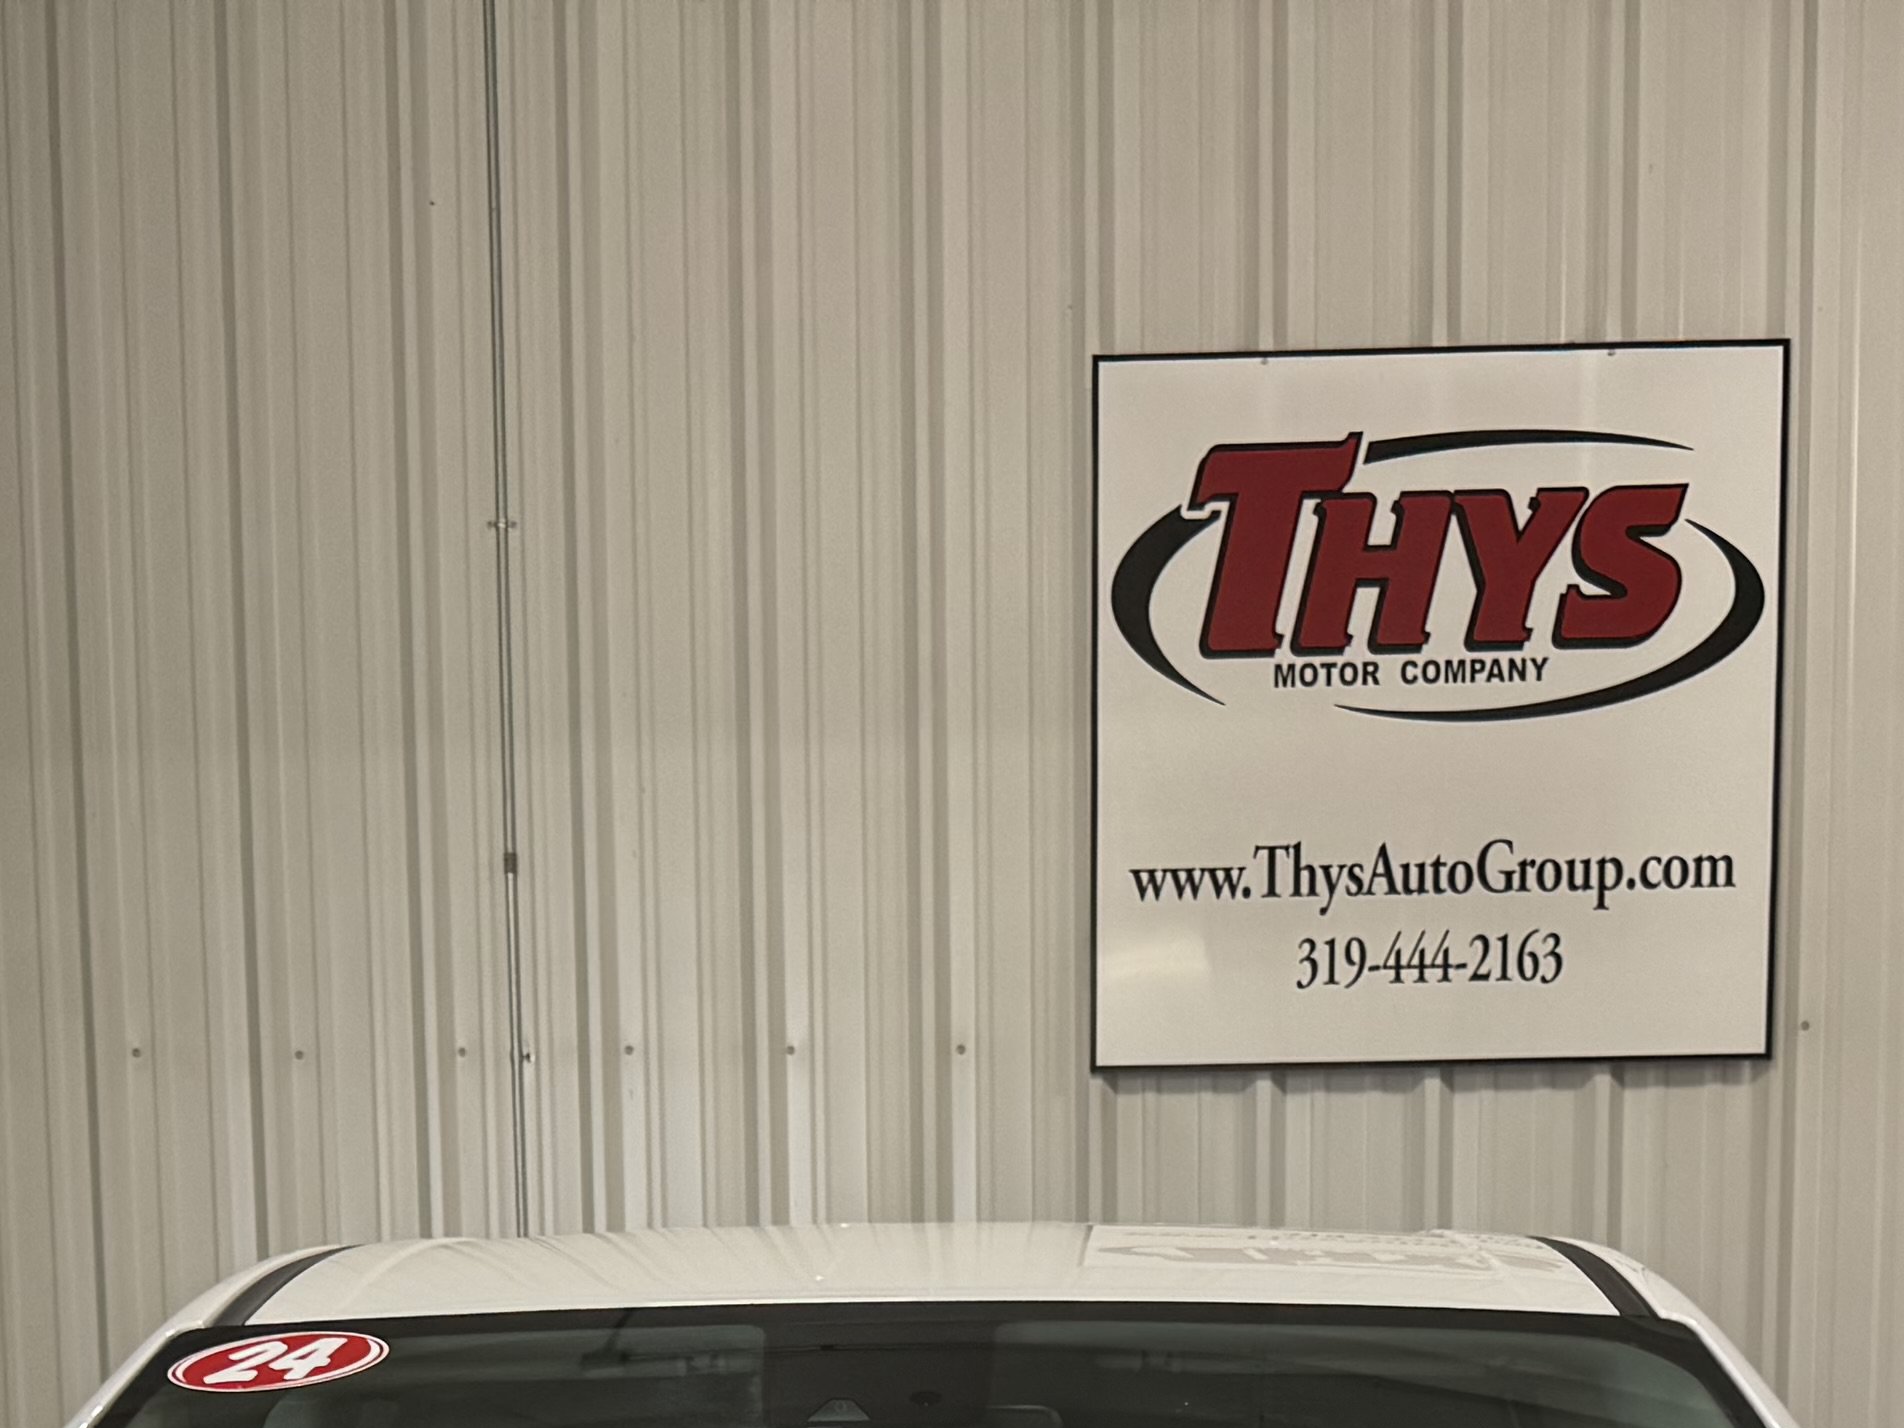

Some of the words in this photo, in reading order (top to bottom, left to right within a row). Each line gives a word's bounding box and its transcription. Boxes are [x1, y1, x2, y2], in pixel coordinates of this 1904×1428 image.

[1187, 431, 1689, 659] THYS
[1273, 660, 1381, 689] MOTOR
[1400, 657, 1550, 684] COMPANY
[1128, 838, 1737, 916] www.ThysAutoGroup.com
[1295, 928, 1563, 990] 319-444-2163
[202, 1336, 348, 1385] 24
